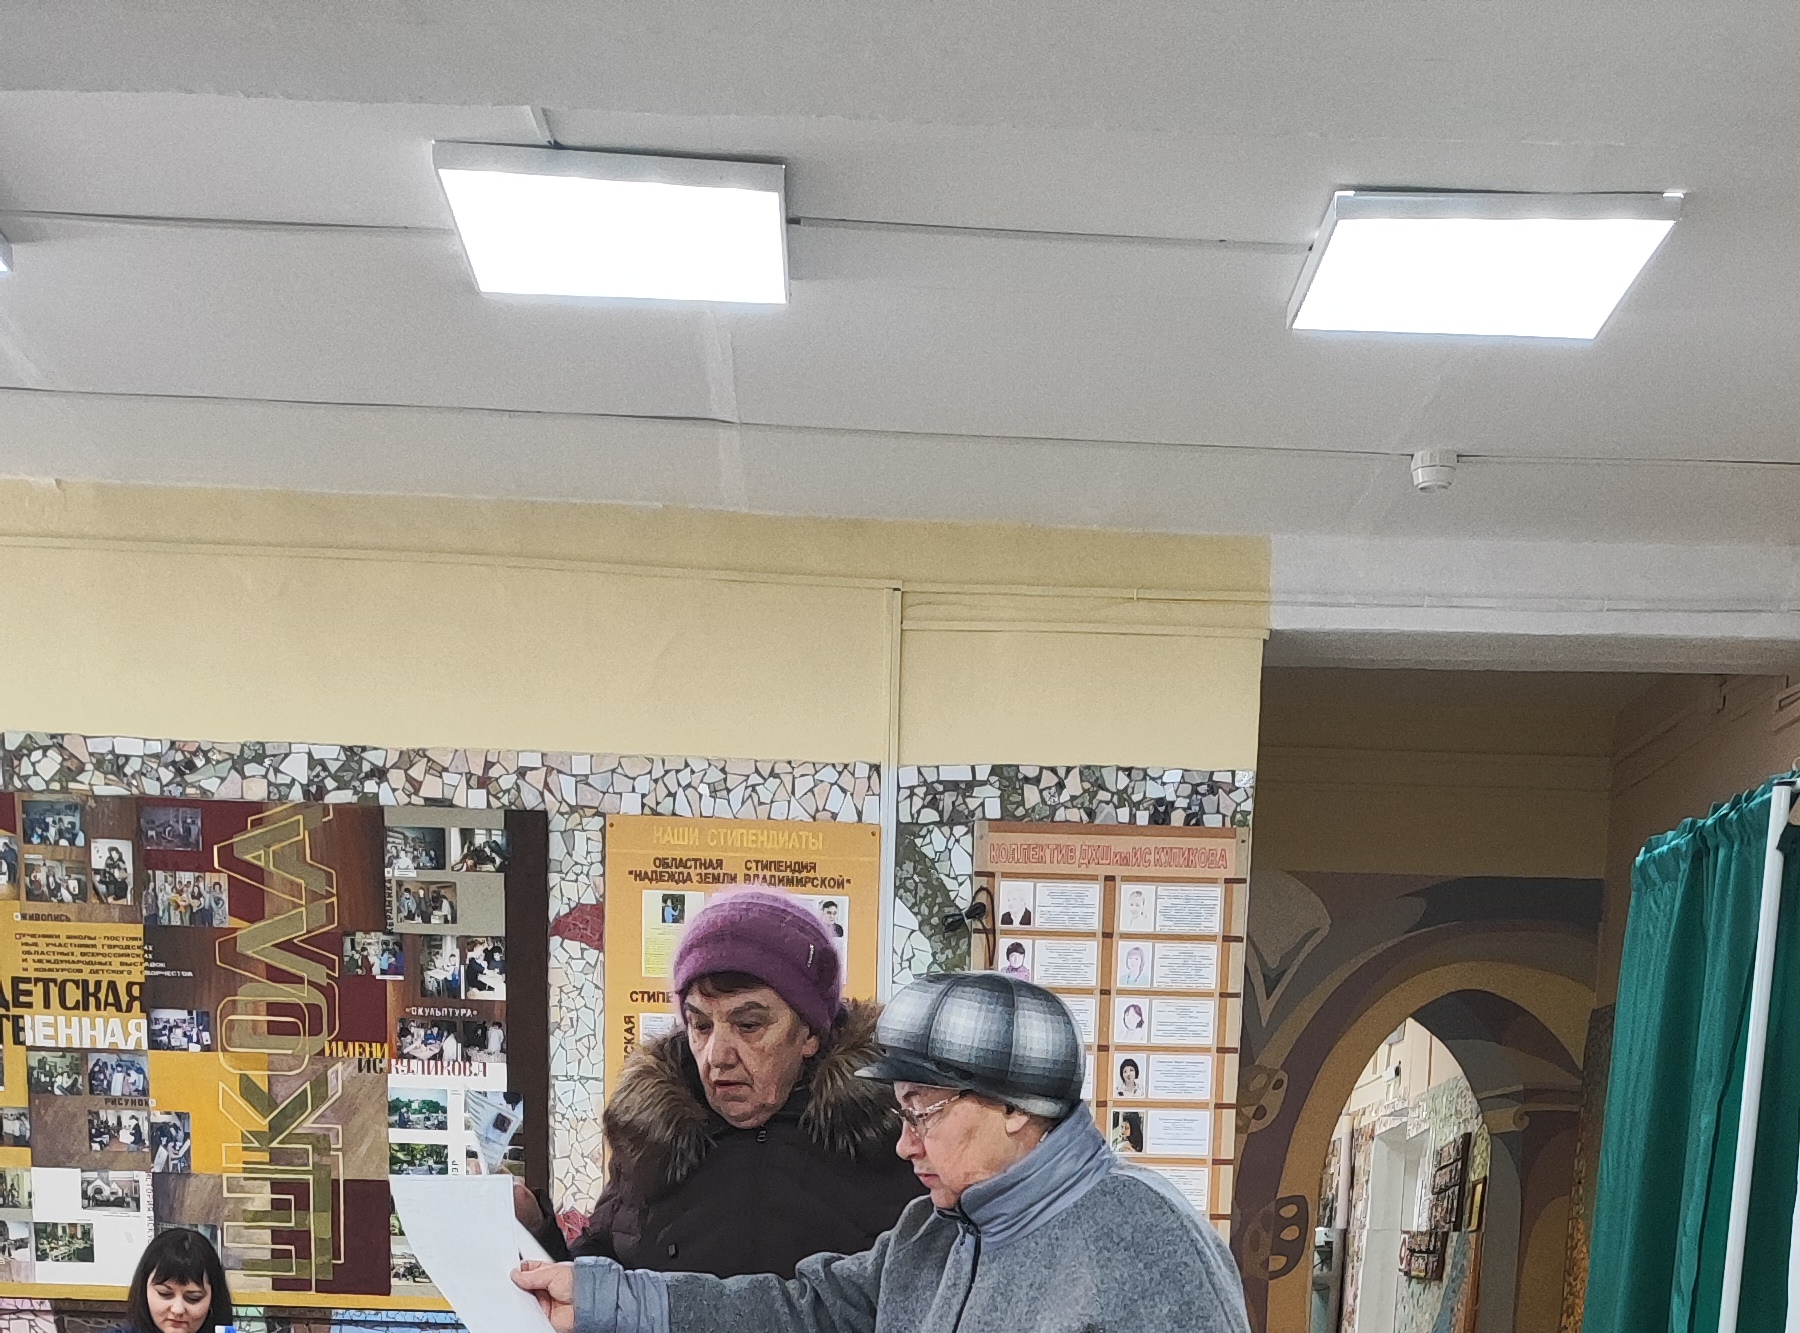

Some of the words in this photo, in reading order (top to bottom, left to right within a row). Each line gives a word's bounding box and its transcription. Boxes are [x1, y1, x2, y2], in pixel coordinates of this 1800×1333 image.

[653, 826, 700, 846] НАШИ
[706, 828, 824, 851] СТИПЕНДИАТЫ
[989, 842, 1077, 865] КОЛЛЕКТИВ
[1078, 844, 1112, 868] ДХШ
[1153, 846, 1228, 869] КУЛИКОВА
[652, 856, 724, 871] ОБЛАСТНАЯ
[744, 859, 818, 874] СТИПЕНДИЯ
[695, 872, 738, 885] ЗЕМЛИ
[20, 912, 72, 922] ЖИВОПИСЬ
[630, 991, 672, 1003] СТИПЕ
[214, 803, 343, 1294] ШКОЛА
[324, 1041, 390, 1059] ИМЕНИ
[388, 1059, 488, 1078] КУЛИКОВА
[104, 1097, 150, 1107] РИСУНОК
